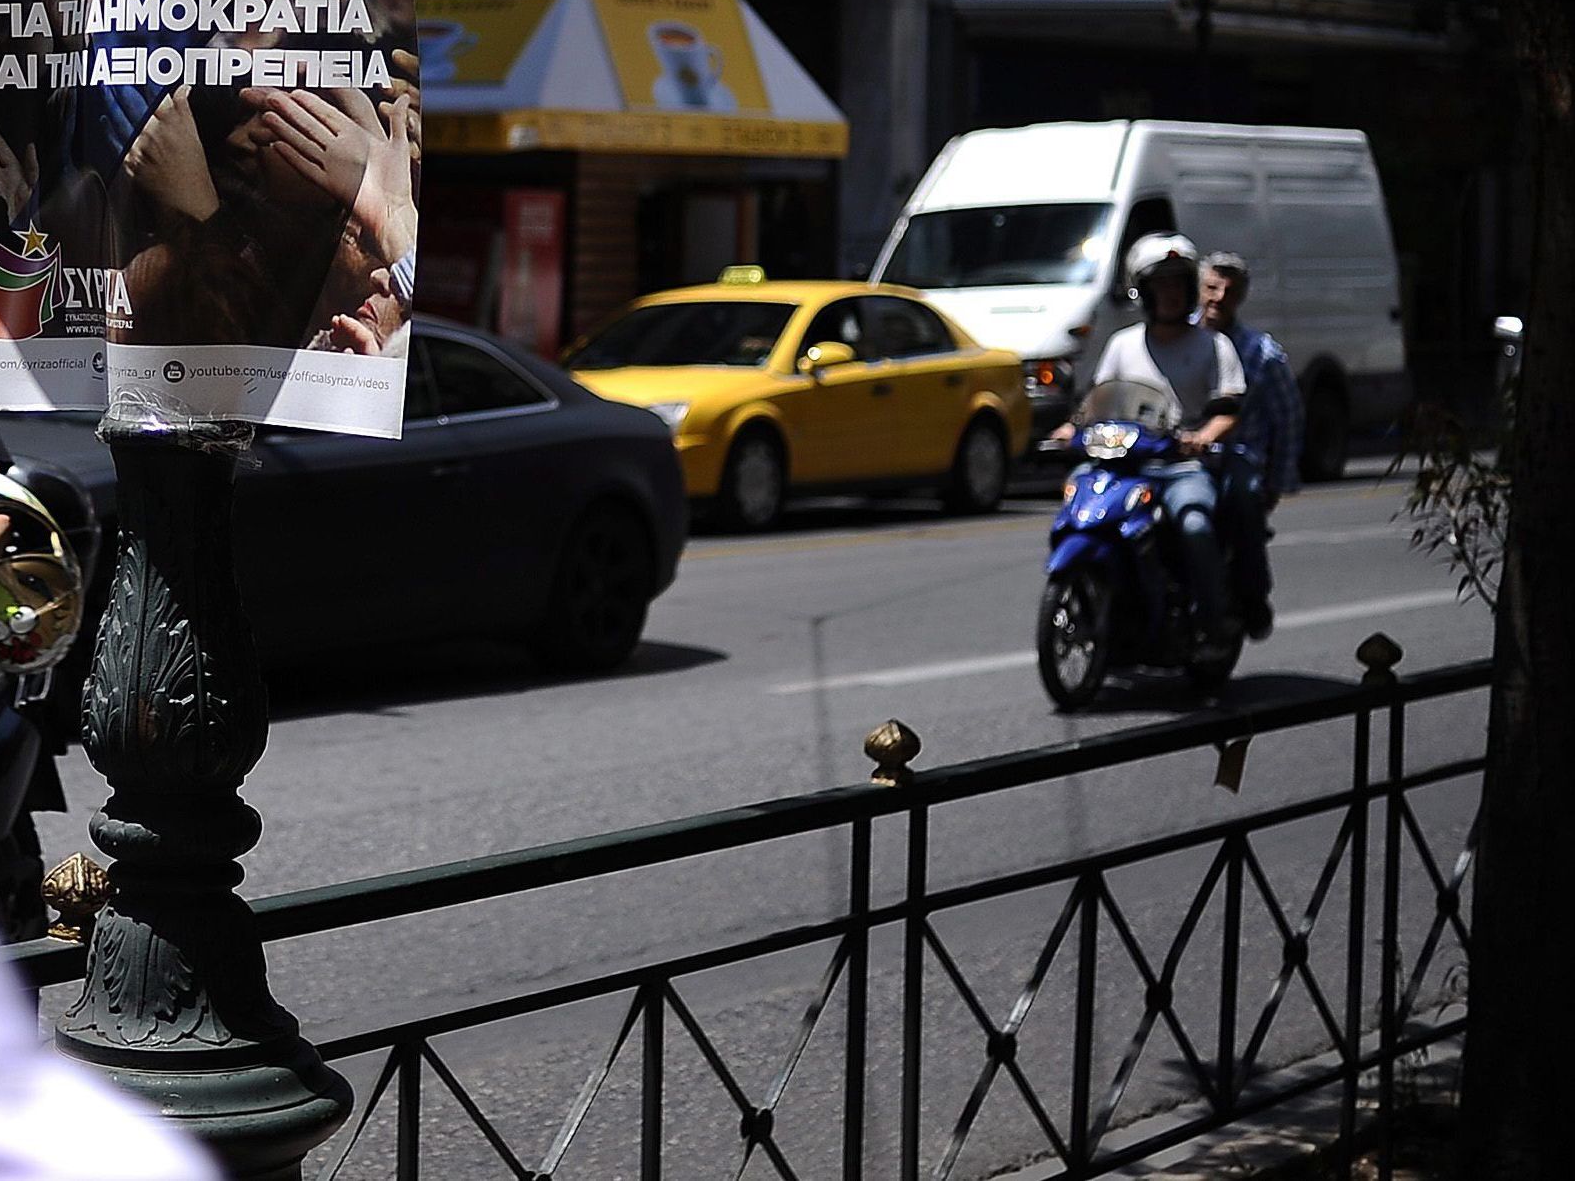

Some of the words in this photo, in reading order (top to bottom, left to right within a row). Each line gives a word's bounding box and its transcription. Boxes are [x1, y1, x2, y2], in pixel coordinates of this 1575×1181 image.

[58, 0, 86, 37] ΤΗ
[45, 50, 88, 89] ΤΗΝ
[89, 45, 392, 90] ΑΞΙΟΠΡΕΠΕΙΑ
[189, 365, 390, 392] youtube.com/user/officialsyriza/videos
